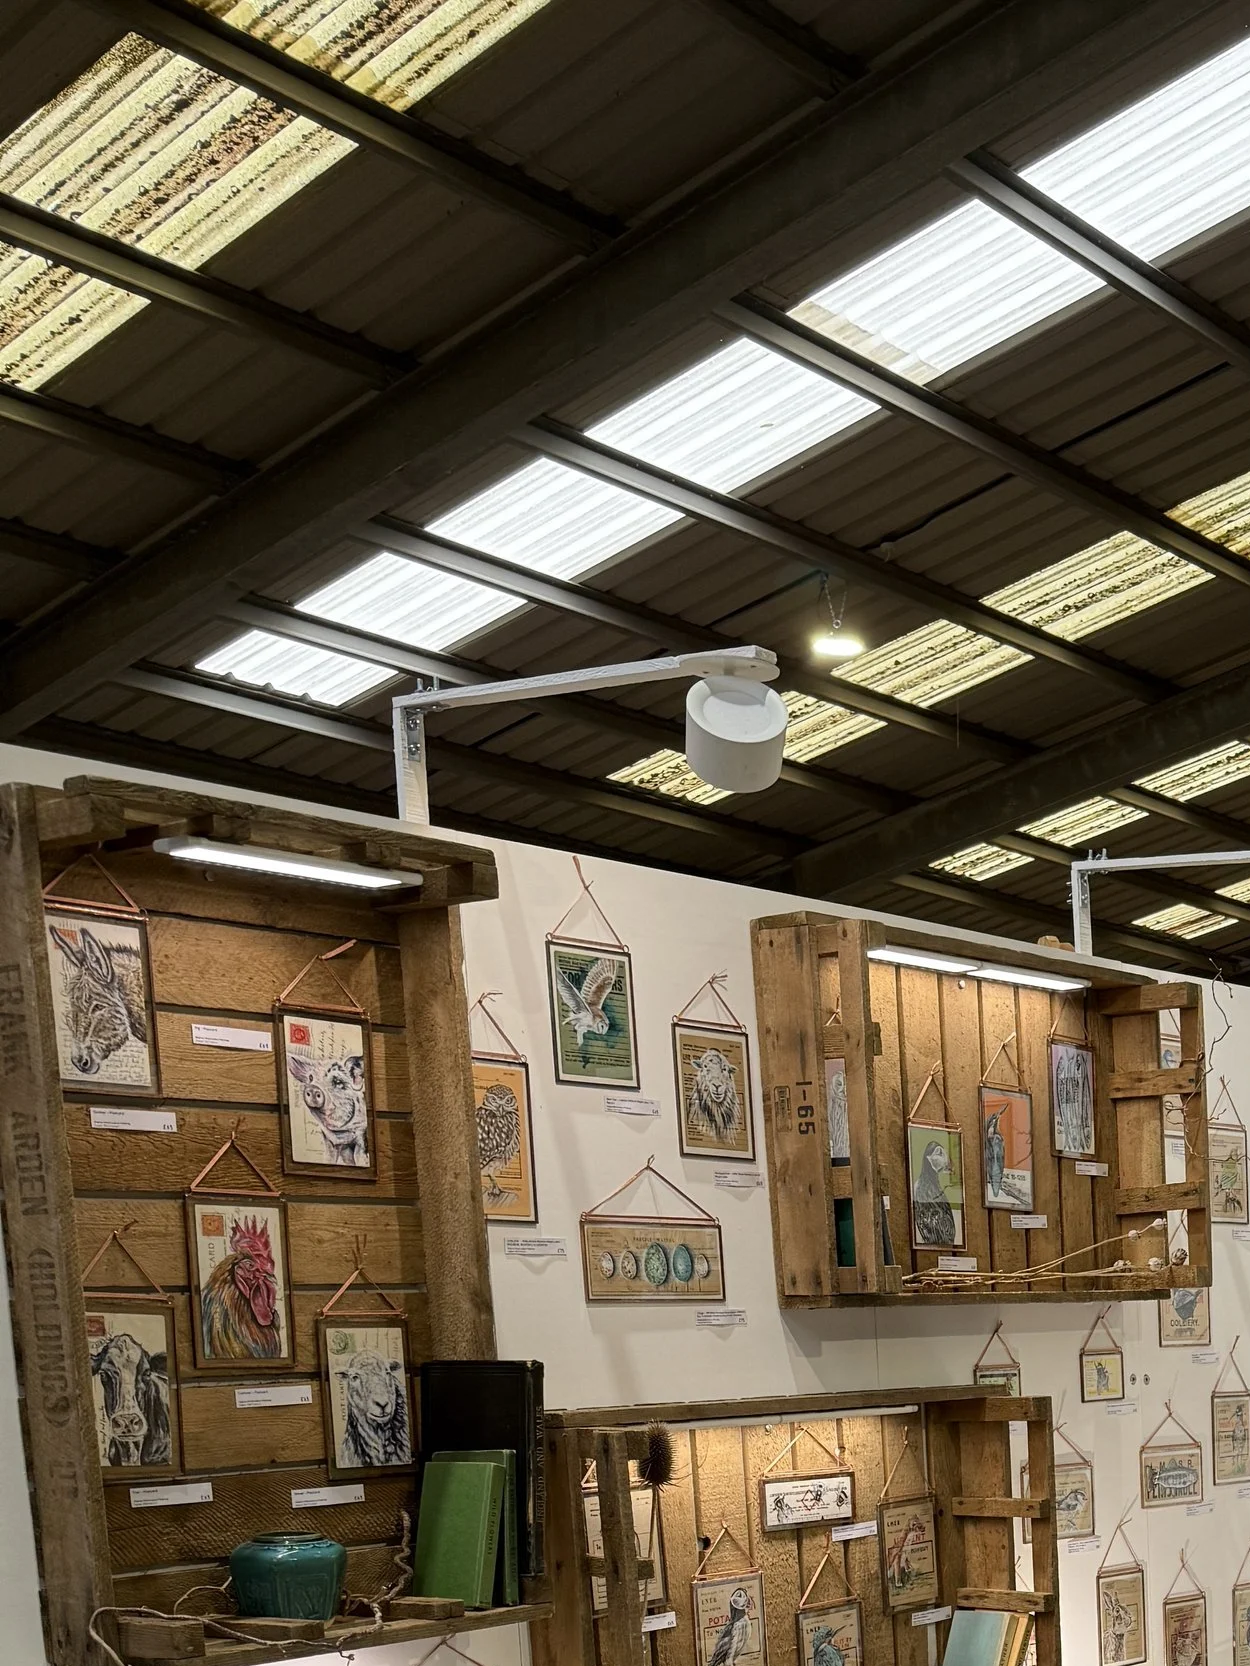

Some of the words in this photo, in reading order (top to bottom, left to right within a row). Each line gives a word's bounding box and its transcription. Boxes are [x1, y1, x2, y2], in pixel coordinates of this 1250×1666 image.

[11, 1110, 49, 1217] ARDEN
[535, 1405, 545, 1440] WALES
[535, 1446, 545, 1468] AND
